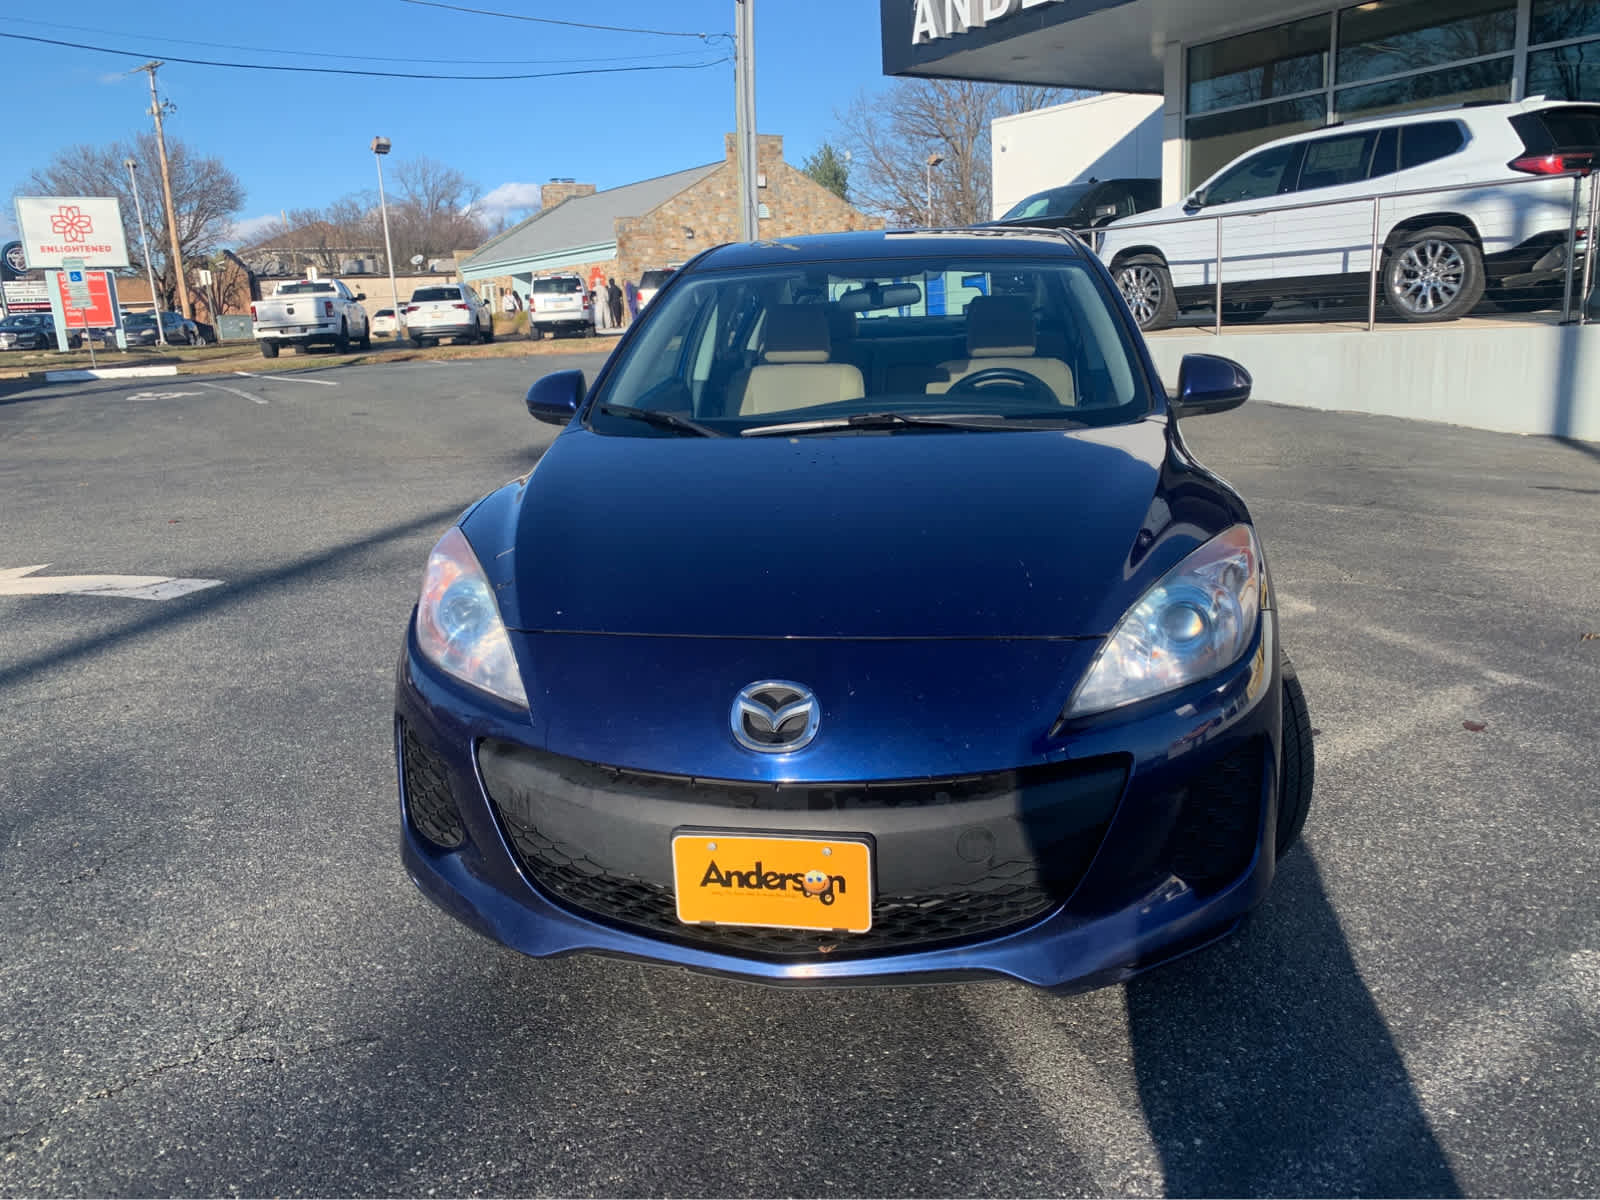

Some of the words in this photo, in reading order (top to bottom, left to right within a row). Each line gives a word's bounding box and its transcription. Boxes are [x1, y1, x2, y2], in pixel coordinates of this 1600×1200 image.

[911, 0, 1064, 44] AND
[40, 245, 112, 253] ENLIGHTENED
[700, 859, 846, 904] Anderson
